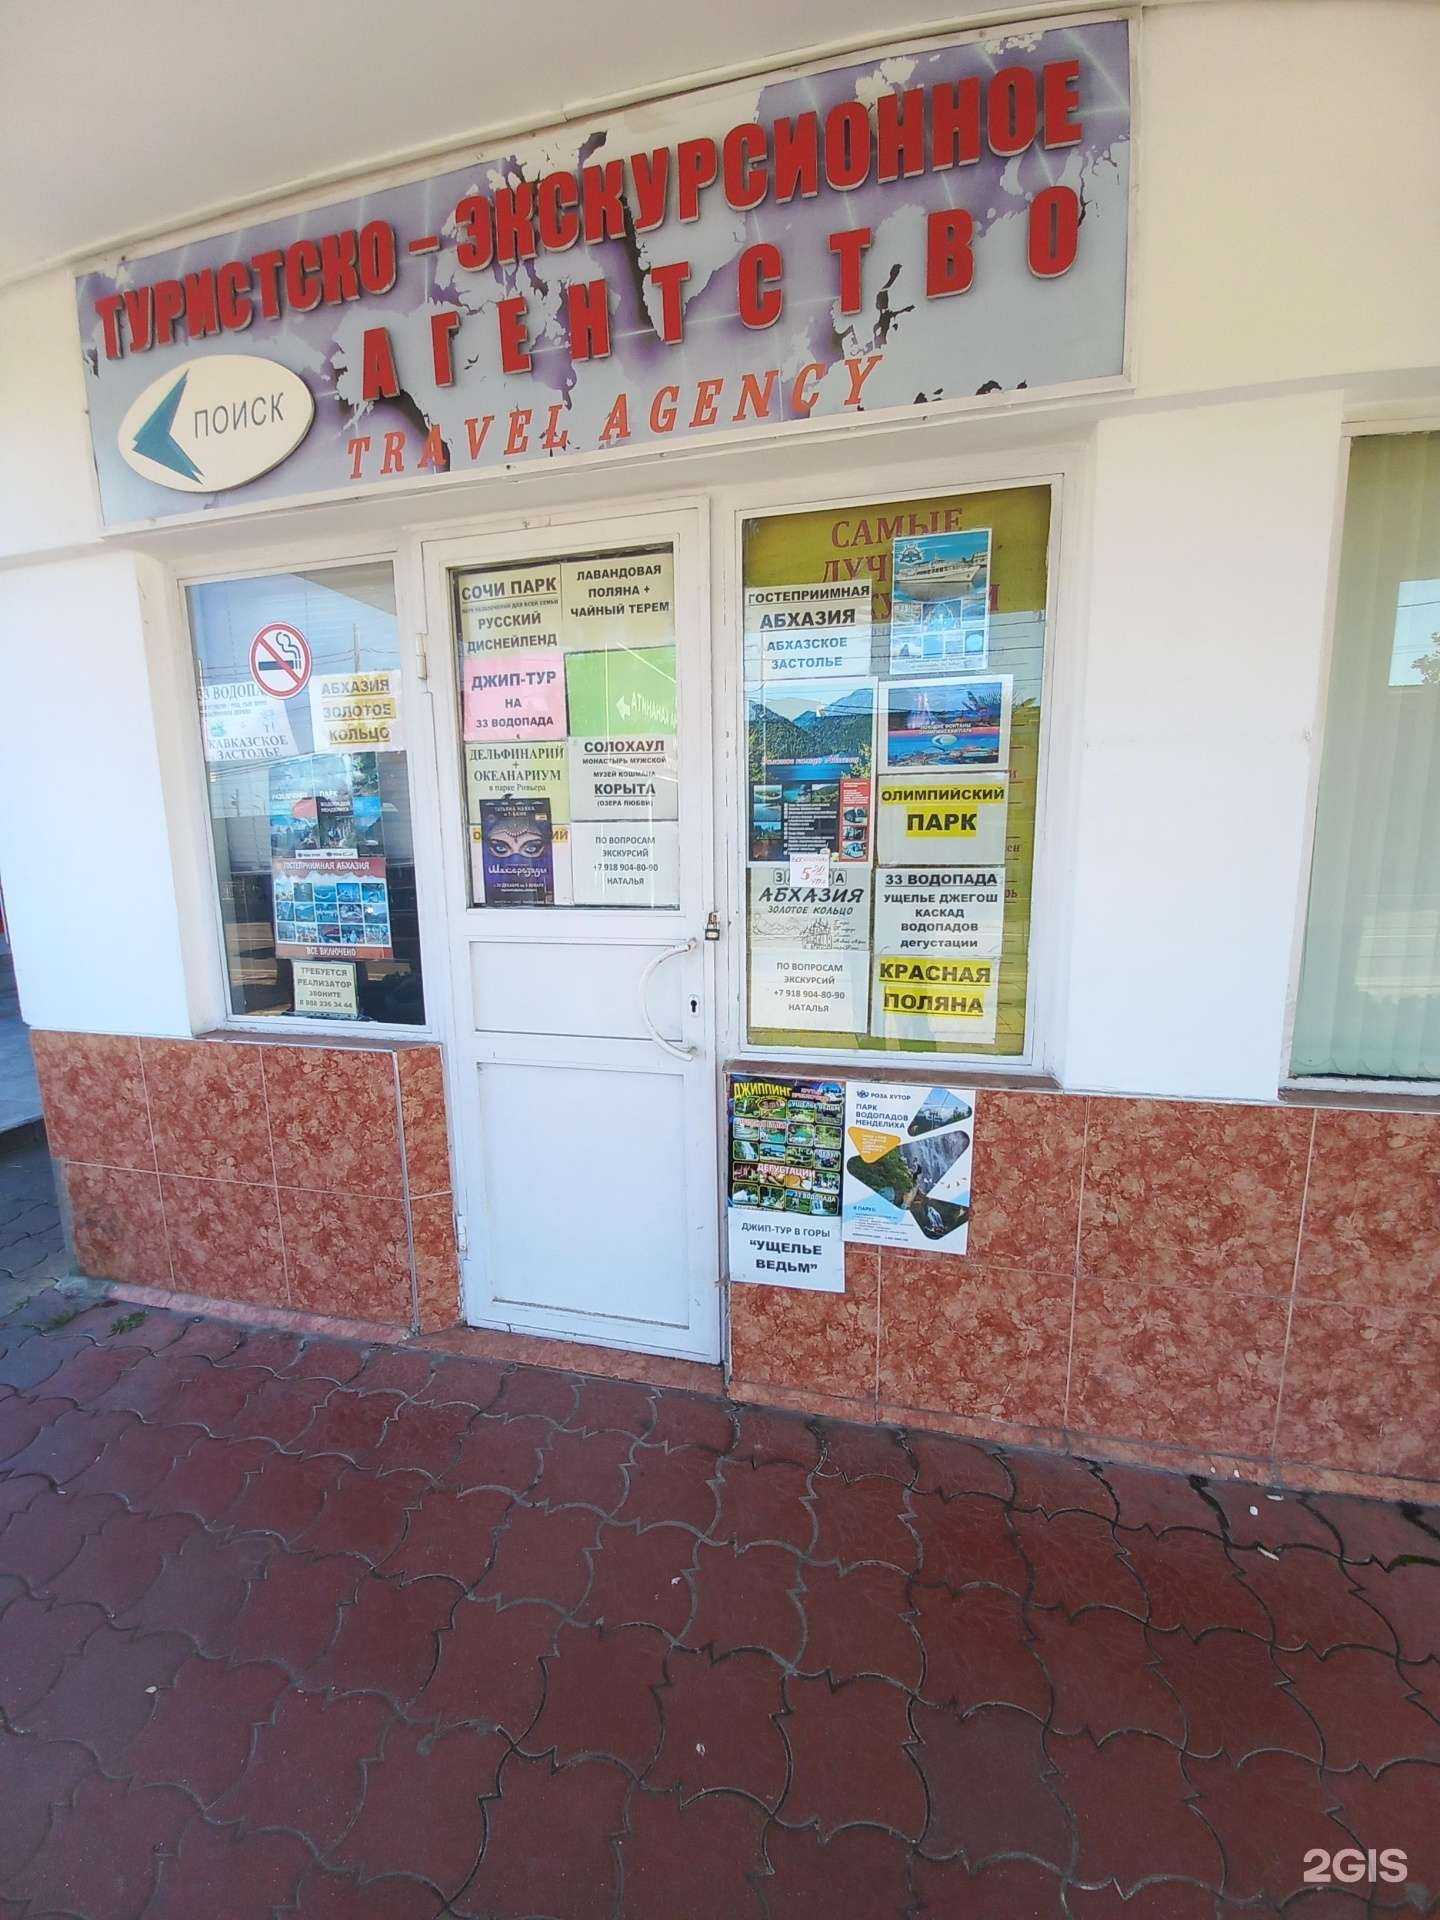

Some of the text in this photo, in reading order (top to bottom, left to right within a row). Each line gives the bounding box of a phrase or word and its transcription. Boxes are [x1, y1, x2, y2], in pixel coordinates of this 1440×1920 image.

[455, 59, 1083, 271] ЭКСКУРСИОННОЕ
[362, 185, 1079, 401] АГЕНТСТВО
[194, 392, 284, 439] ПОИСК
[346, 354, 884, 480] TRAVEL AGENCY
[576, 565, 662, 581] ЛАВАНДОВАЯ
[462, 576, 558, 601] СОЧИ ПАРК
[588, 587, 640, 598] ПОЛЯНА
[748, 586, 871, 603] ГОСТЕПРИИМНАЯ
[571, 602, 669, 618] ЧАЙНЫЙ ТЕРЕМ
[478, 610, 541, 629] РУССКИЙ
[759, 609, 856, 629] АБХАЗИЯ
[467, 633, 558, 654] ДИСНЕЙЛЕНД
[767, 637, 848, 652] АБХАЗСКОЕ
[771, 656, 843, 670] ЗАСТОЛЬЕ
[321, 679, 390, 695] АБХАЗИЯ
[471, 671, 557, 692] ДЖИП-ТУР
[504, 698, 522, 709] НА
[323, 703, 392, 719] ЗОЛОТОЕ
[476, 716, 554, 728] 33 ВОДОПАДА
[329, 727, 390, 743] КОЛЬЦО
[584, 740, 665, 753] СОЛОХАУЛ
[469, 747, 564, 762] ДЕЛЬФИНАРИЙ
[582, 756, 667, 765] МОНАСТЫРЬ МУЖСКОЙ
[474, 770, 561, 781] ОКЕАНАРИУМ
[593, 770, 617, 778] МУЗЕЙ
[594, 783, 656, 795] КОРЫТА
[881, 785, 1005, 802] ОЛИМПИЙСКИЙ
[906, 813, 977, 831] ПАРК
[595, 836, 656, 845] ПО ВОПРОСАМ
[602, 848, 649, 857] ЭКСКУРСИЙ
[607, 877, 645, 885] НАТАЛЬЯ
[885, 873, 998, 886] 33 ВОДОПАДА
[759, 887, 865, 903] АБХАЗИЯ
[883, 894, 937, 905] УЩЕЛЬЕ
[939, 893, 998, 905] ДЖЕГОШ
[768, 905, 854, 916] ЗОЛОТОЕ КОЛЬЦО
[915, 909, 965, 919] КАСКАД
[900, 922, 979, 933] ВОДОПАДОВ
[900, 938, 978, 949] дегустации
[301, 967, 348, 977] ТРЕБУЕТСЯ
[776, 962, 843, 972] ПО ВОПРОСАМ
[880, 963, 991, 983] КРАСНАЯ
[297, 979, 352, 989] РЕАЛИЗАТОР
[783, 975, 835, 985] ЭКСКУРСИЙ
[774, 989, 845, 999] +7 918 904-80-90
[788, 1004, 829, 1013] НАТАЛЬЯ
[883, 992, 984, 1014] ПОЛЯНА
[733, 1082, 793, 1099] ДЖИППИНГ
[855, 1103, 878, 1111] ПАРК
[855, 1112, 909, 1122] ВОДОПАДОВ
[855, 1120, 906, 1129] МЕНДЕЛИХА
[757, 1163, 816, 1178] ДЕГУСТАЦИИ
[741, 1222, 830, 1238] ДЖИП-ТУР В ГОРЫ
